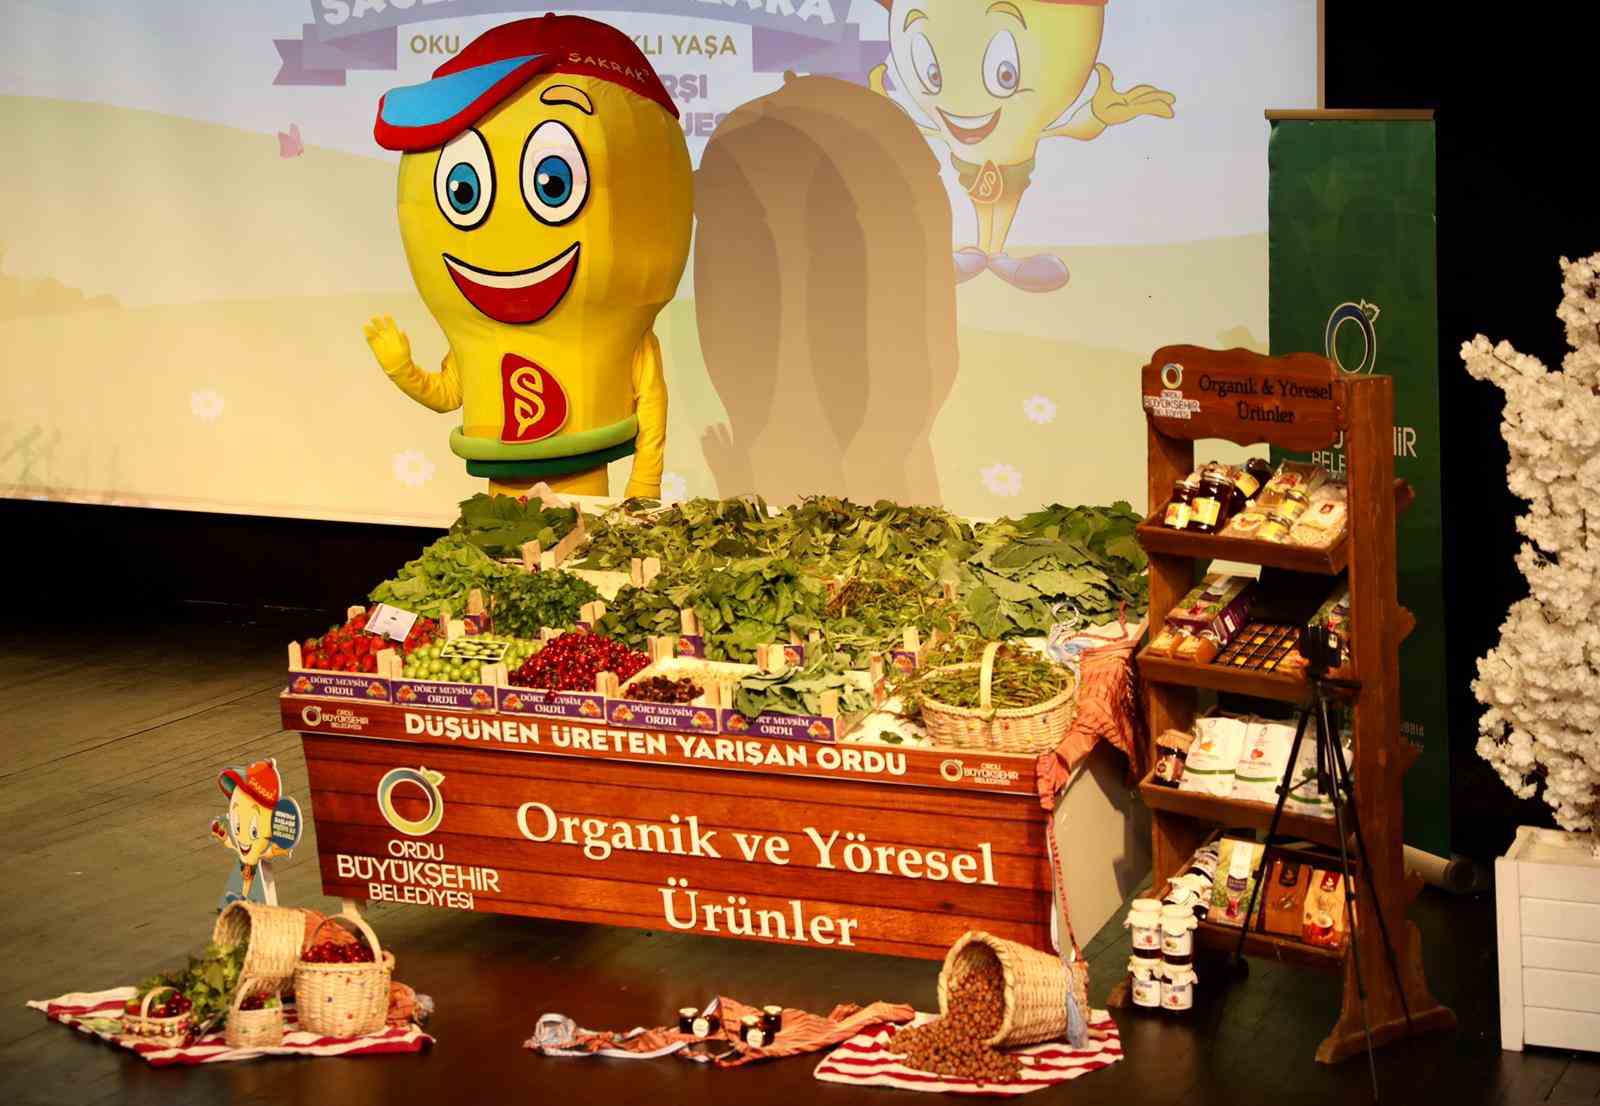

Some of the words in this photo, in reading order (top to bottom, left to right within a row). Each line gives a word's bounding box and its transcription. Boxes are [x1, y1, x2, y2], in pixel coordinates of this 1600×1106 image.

[410, 35, 460, 54] OKU
[671, 34, 736, 60] YAŞA
[1199, 374, 1259, 397] Organik
[1263, 377, 1275, 395] &
[1277, 379, 1332, 401] Yöresel
[1238, 400, 1295, 424] Ürünler
[310, 675, 333, 686] DÖRT
[335, 677, 369, 689] MEVSİM
[324, 685, 354, 697] ORDU
[413, 684, 437, 694] DÖRT
[439, 685, 473, 696] MEVSİM
[427, 694, 459, 705] ORDU
[520, 693, 545, 703] DÖRT
[554, 696, 582, 706] EVSİM
[534, 703, 567, 714] ORDU
[630, 703, 656, 715] DÖRT
[657, 706, 694, 718] MEVSİM
[645, 715, 677, 727] ORDU
[772, 716, 810, 728] MEVSİM
[760, 725, 793, 737] ORDU
[404, 712, 540, 745] DÜŞÜNEN
[551, 725, 668, 756] ÜRETEN
[675, 735, 808, 768] YARIŞAN
[816, 746, 907, 777] ORDU
[387, 838, 445, 862] ORDU
[515, 801, 722, 861] Organik
[732, 831, 791, 865] ve
[802, 826, 1000, 887] Yöresel
[336, 853, 501, 893] BÜYÜKŞEHİR
[368, 882, 475, 911] BELEDİYESİ
[658, 877, 859, 947] Ürünler
